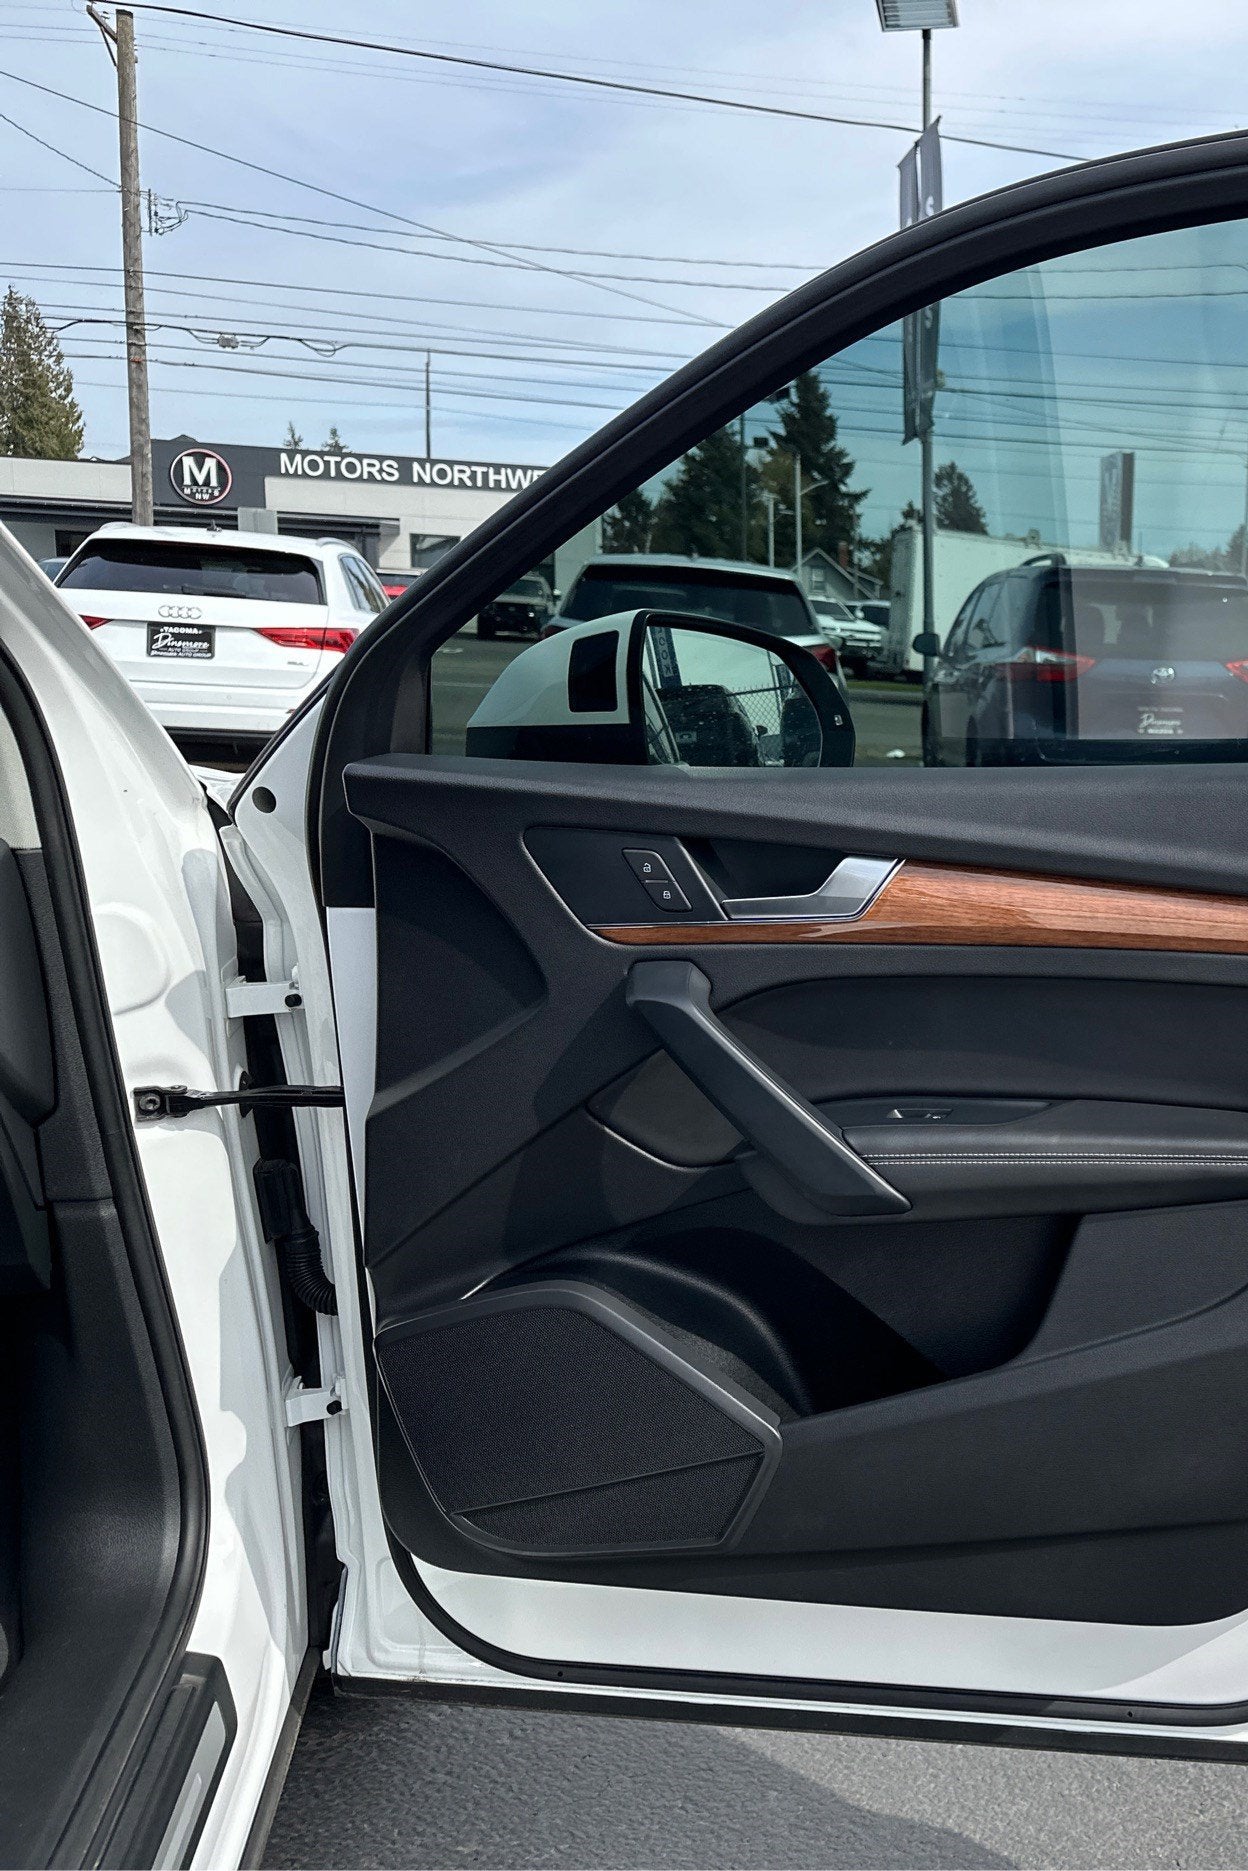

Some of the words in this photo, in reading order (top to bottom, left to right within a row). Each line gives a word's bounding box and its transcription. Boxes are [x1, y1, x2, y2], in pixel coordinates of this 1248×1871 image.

[182, 456, 218, 487] M
[280, 452, 400, 481] MOTORS
[195, 492, 210, 500] NW
[163, 626, 199, 634] TACOMA
